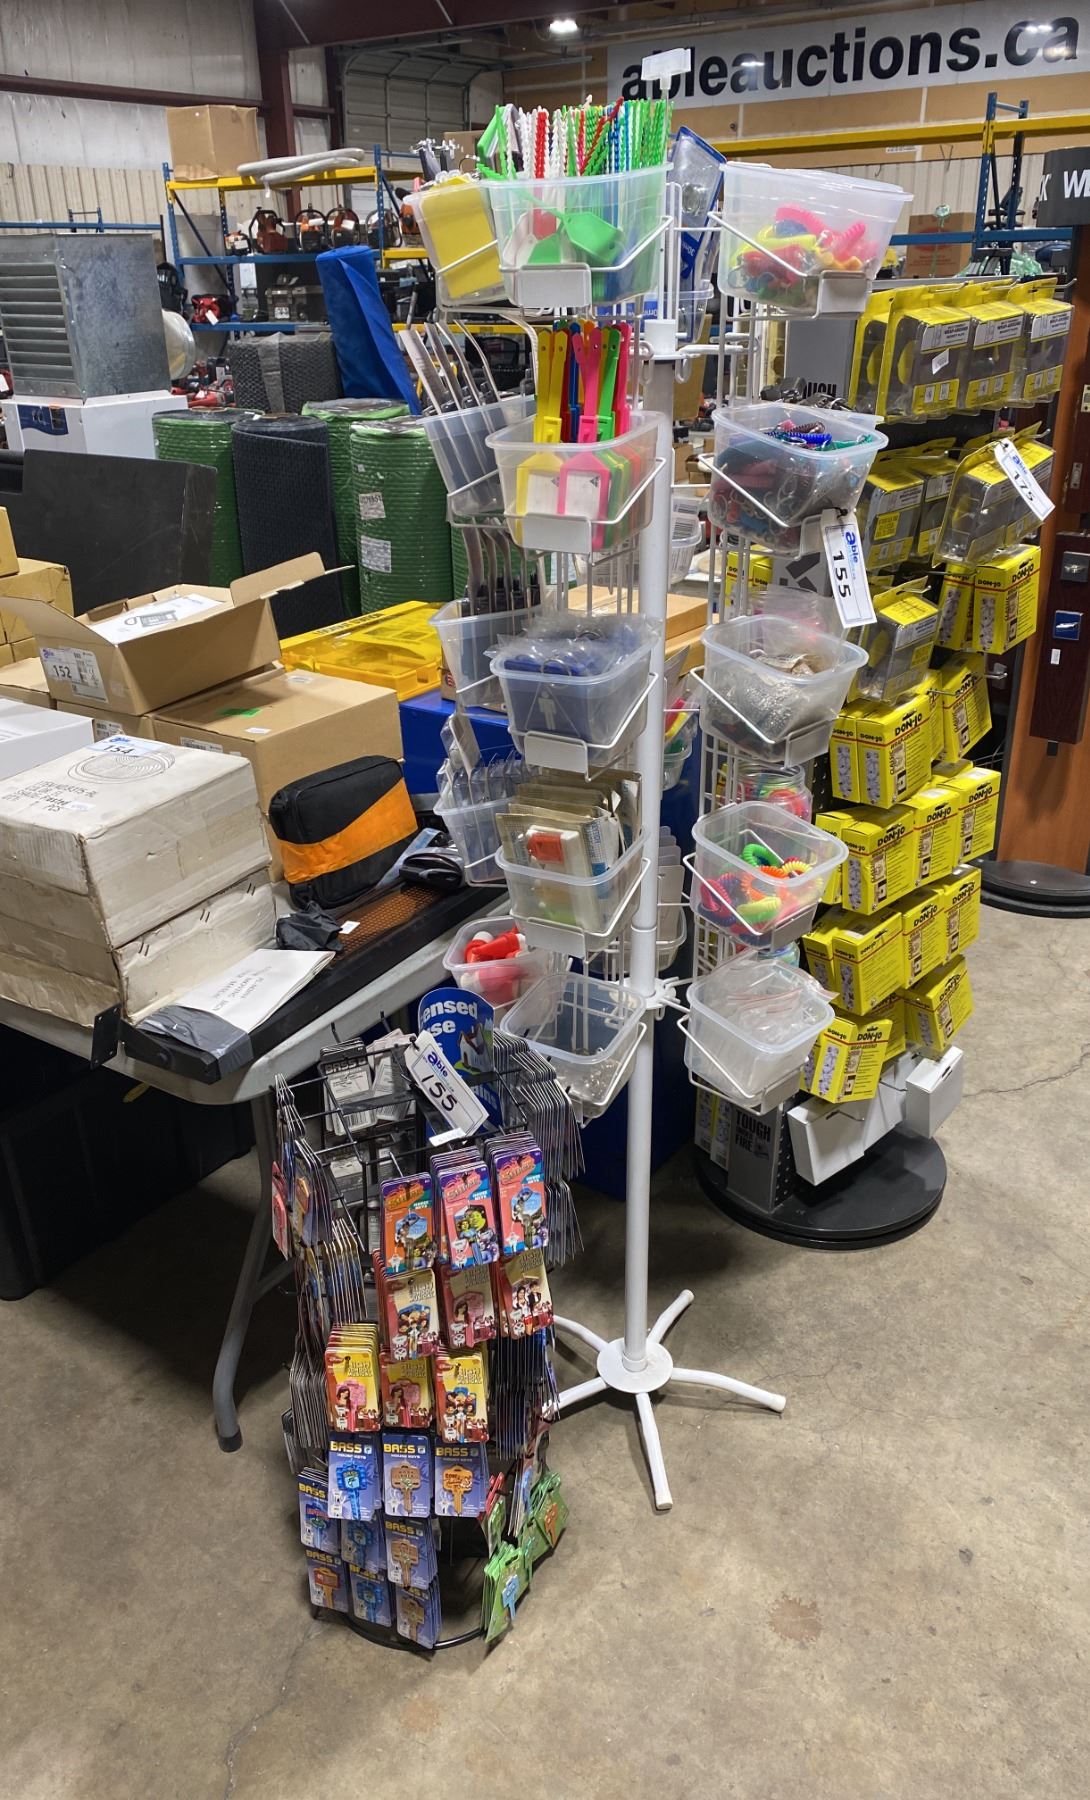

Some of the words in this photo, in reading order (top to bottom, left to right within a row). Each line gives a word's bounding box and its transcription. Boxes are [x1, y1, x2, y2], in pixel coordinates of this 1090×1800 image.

[845, 530, 860, 564] able
[832, 550, 852, 598] 155
[1012, 563, 1035, 583] DON-JO
[53, 664, 73, 680] 152
[894, 713, 923, 736] DON-JO
[103, 745, 136, 755] 154
[968, 786, 993, 804] DON-JO
[926, 806, 952, 824] DON-JO
[877, 826, 906, 847] DON-JO
[953, 883, 975, 905] DON-JO
[913, 905, 938, 927] DON-JO
[421, 1000, 478, 1021] ensed
[857, 1031, 883, 1042] DON-JO
[427, 1051, 449, 1078] able
[421, 1074, 458, 1112] 155
[736, 1108, 771, 1142] TOUGH
[330, 1441, 362, 1453] BASS
[383, 1444, 415, 1453] BASS
[436, 1447, 468, 1457] BASS
[299, 1483, 326, 1499] BASS
[384, 1521, 415, 1534] BASS
[306, 1549, 333, 1563] BASS
